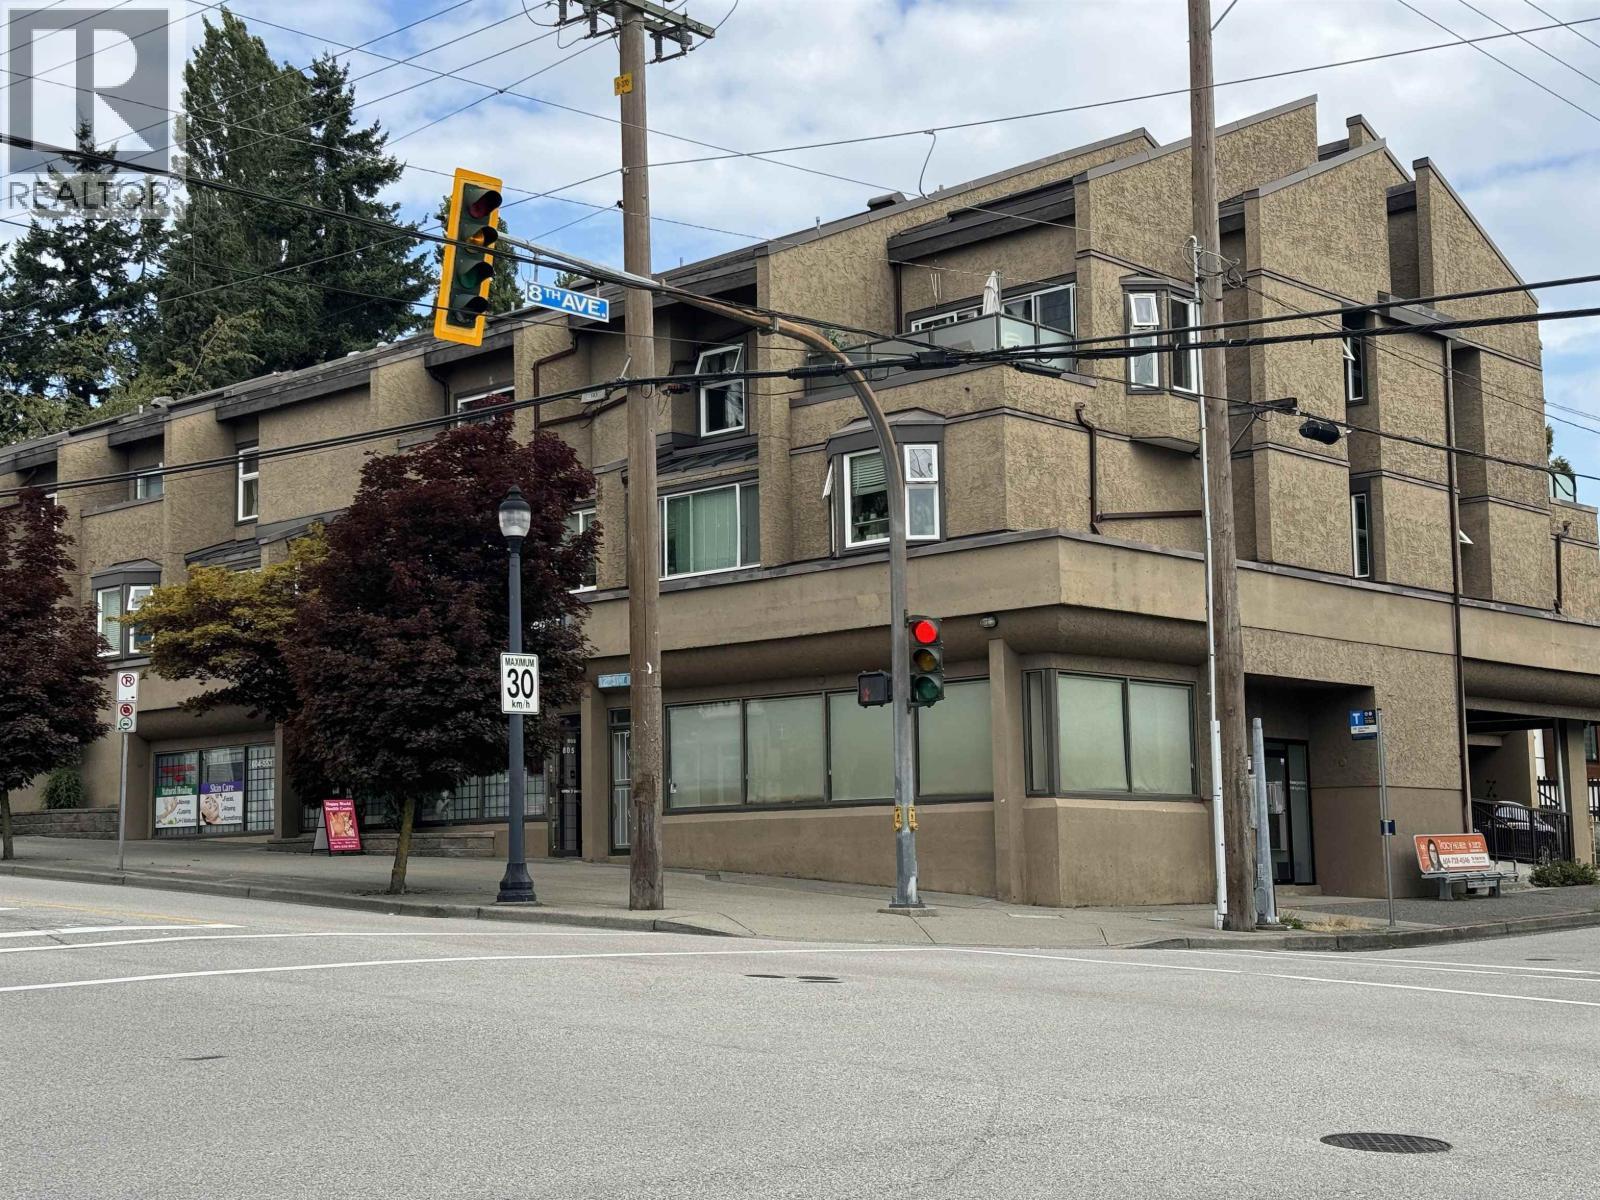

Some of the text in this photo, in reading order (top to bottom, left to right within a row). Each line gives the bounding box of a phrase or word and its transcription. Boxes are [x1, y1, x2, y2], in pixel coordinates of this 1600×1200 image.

[504, 657, 535, 667] MAXIMUM
[507, 668, 534, 699] 30
[511, 700, 531, 709] km/h
[209, 783, 234, 793] Skin Care
